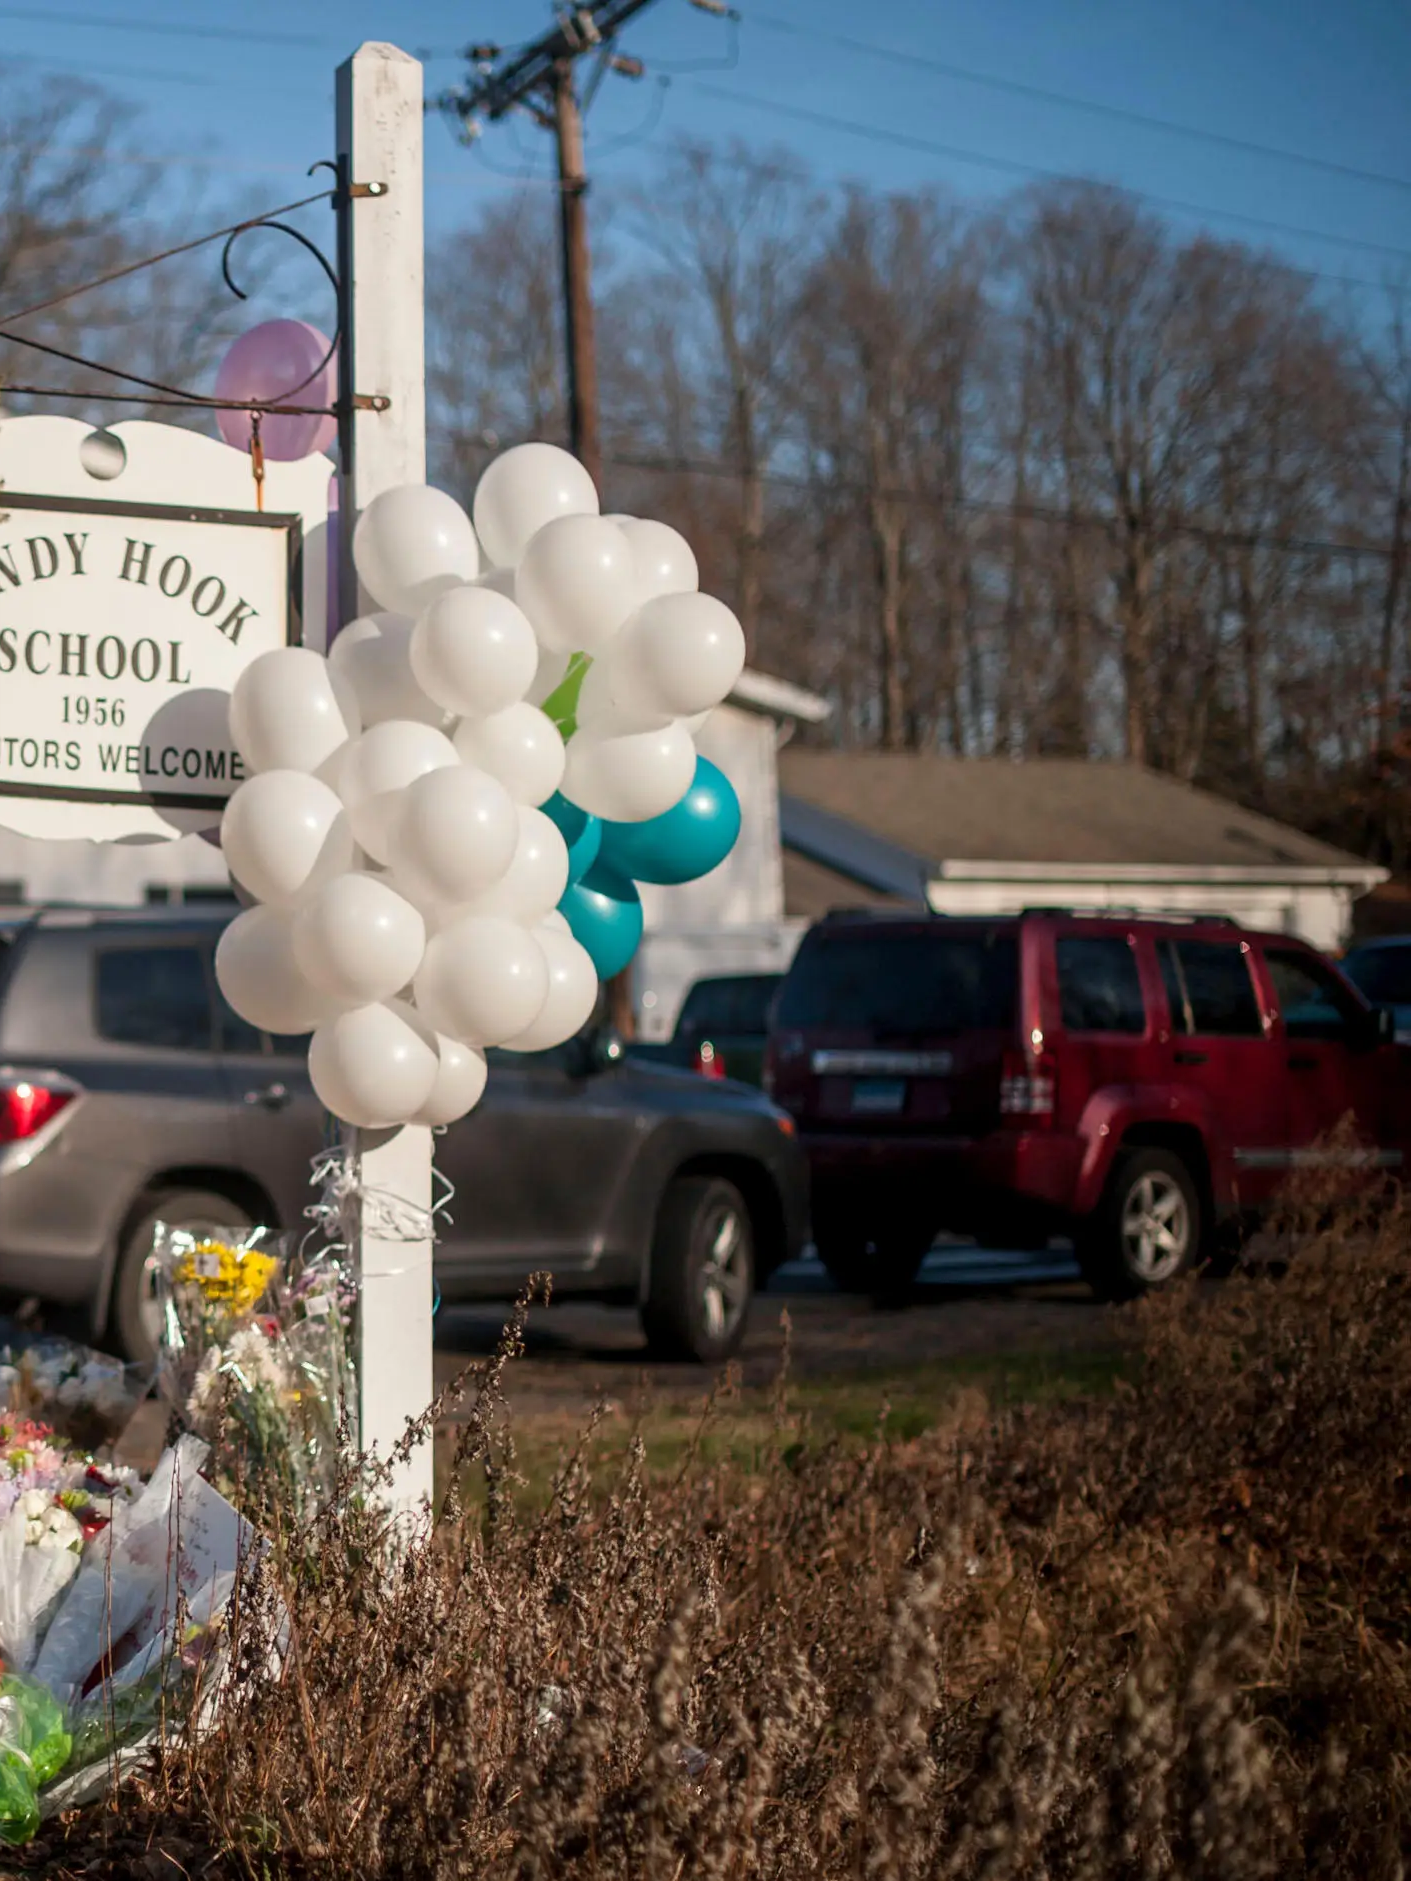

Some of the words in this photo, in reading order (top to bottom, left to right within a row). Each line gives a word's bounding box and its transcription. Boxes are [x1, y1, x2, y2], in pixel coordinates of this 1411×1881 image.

[118, 537, 260, 645] HOOK
[62, 696, 125, 727] 1956
[99, 744, 245, 781] WELCOME
